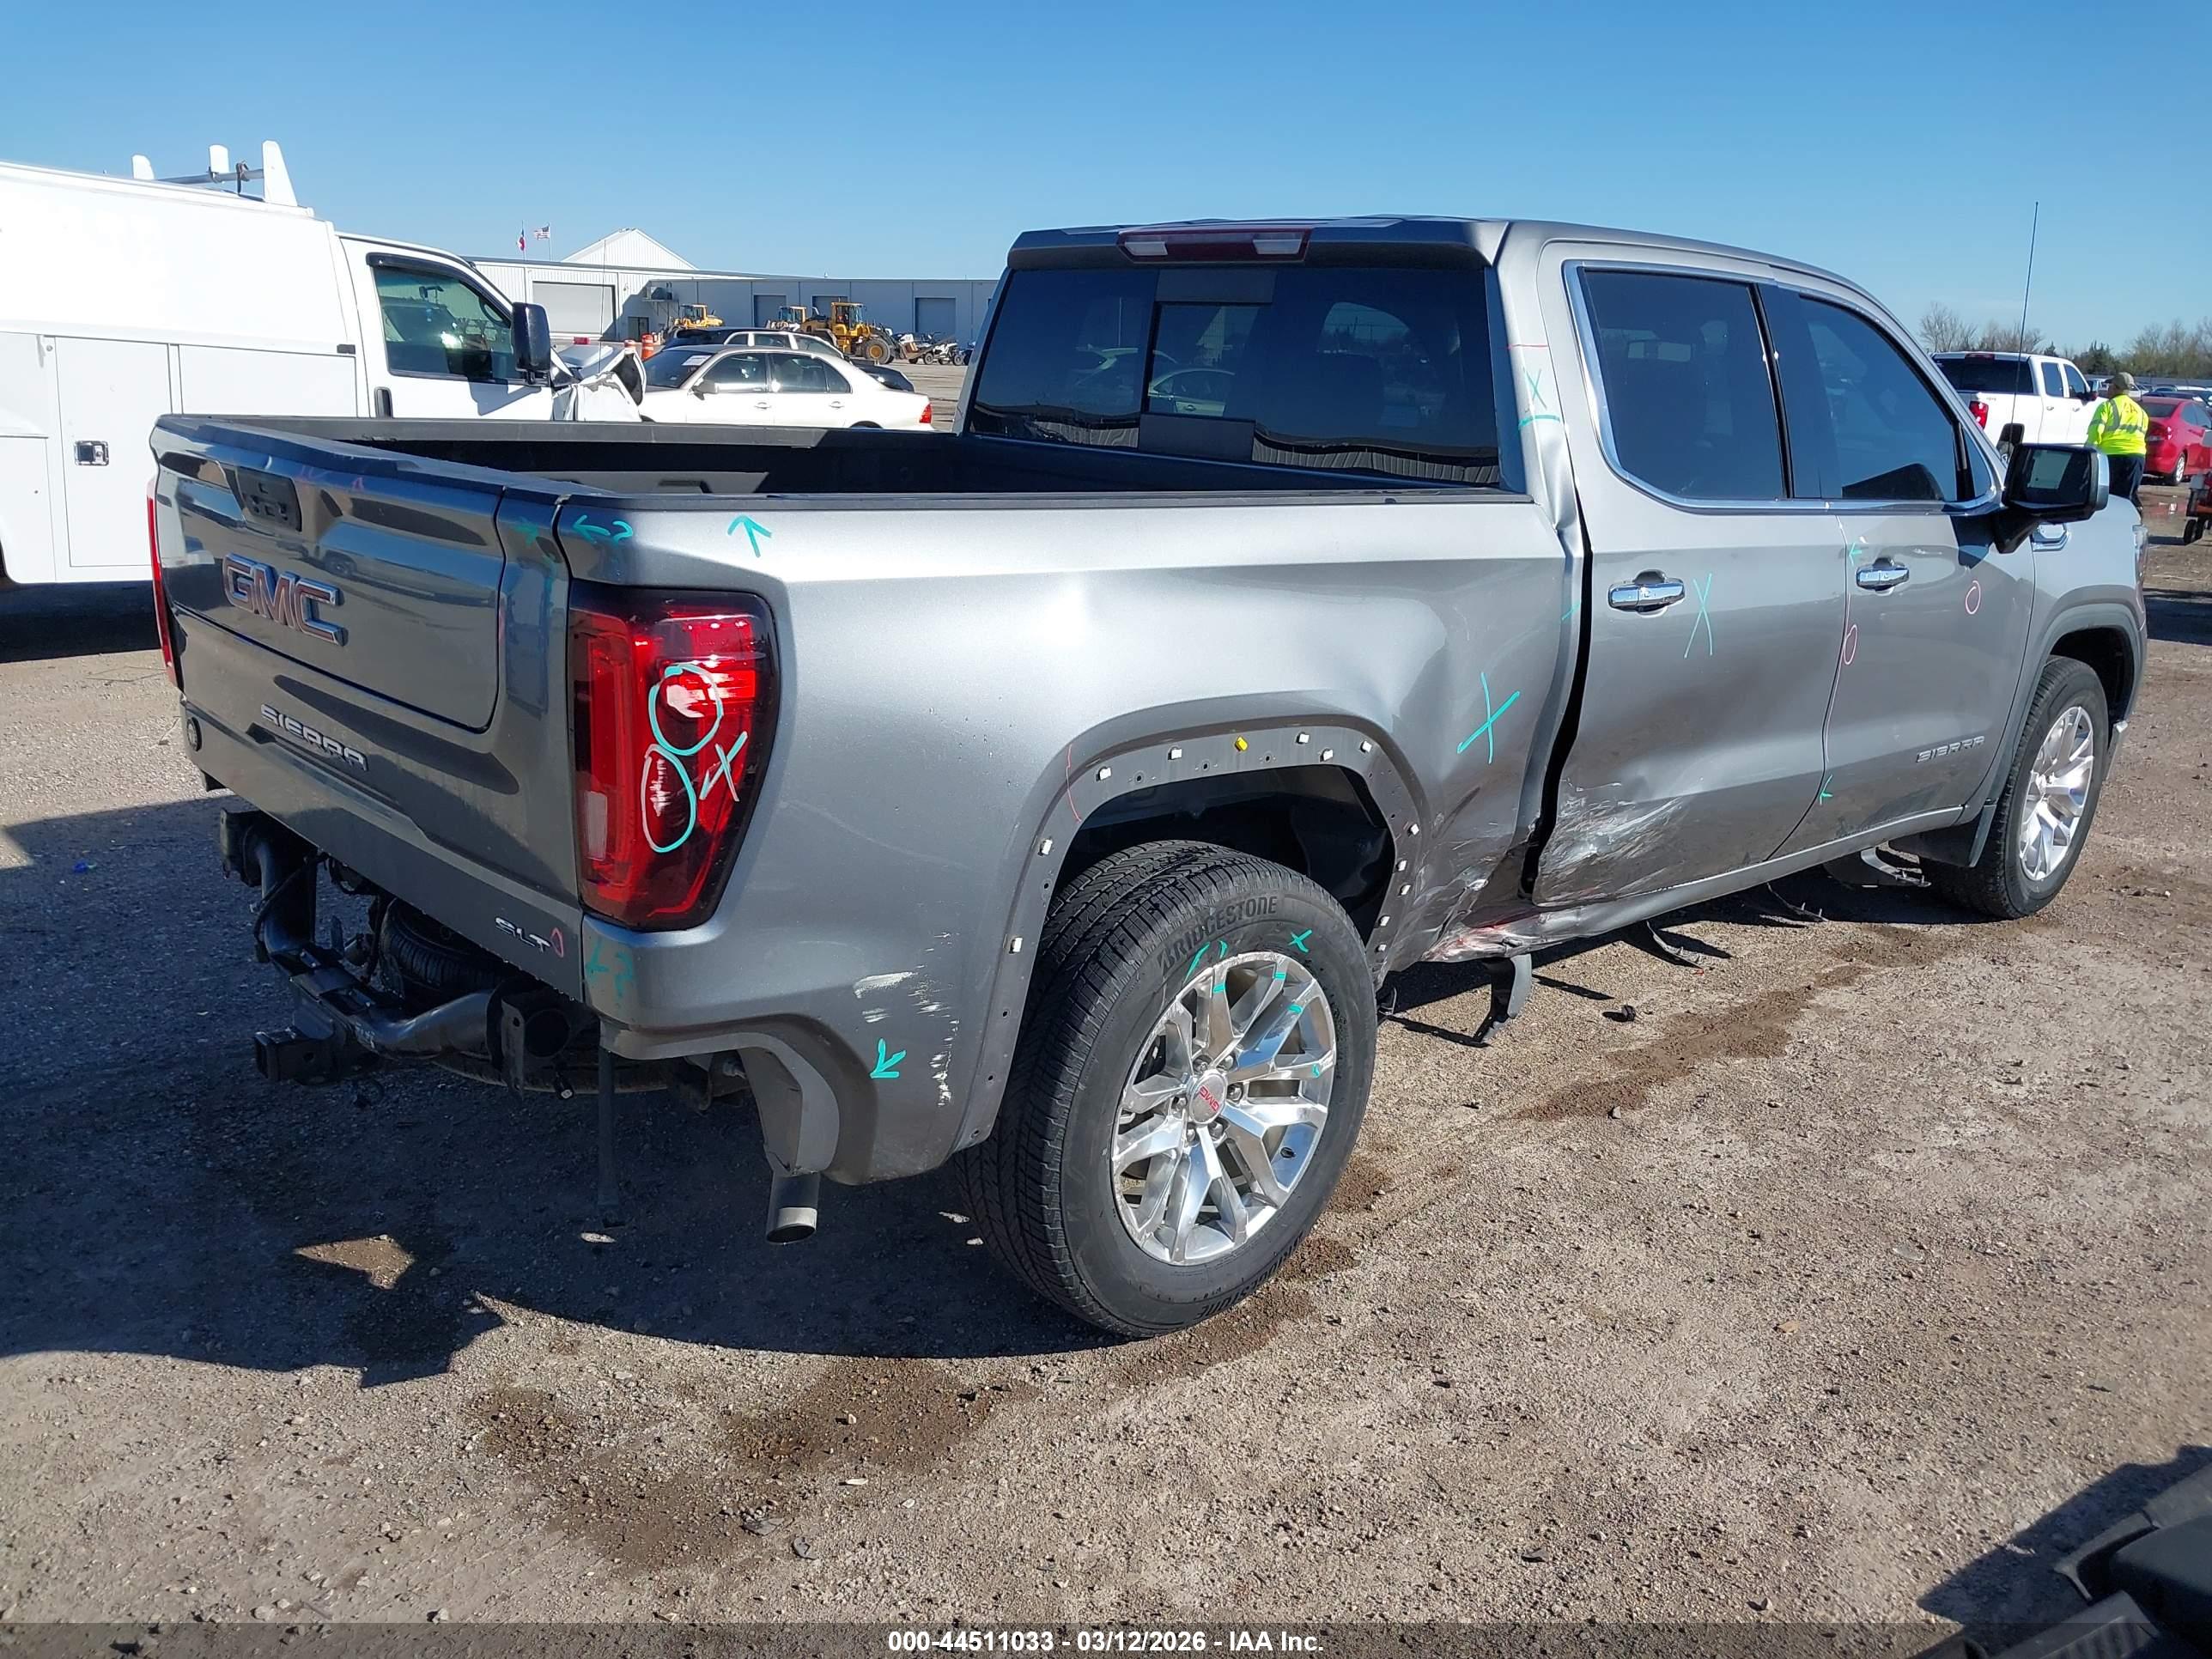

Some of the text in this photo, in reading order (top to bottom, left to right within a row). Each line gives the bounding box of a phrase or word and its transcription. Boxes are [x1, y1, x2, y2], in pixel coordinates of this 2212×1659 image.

[222, 552, 348, 647] GMC
[260, 703, 368, 771] SIERRA
[1916, 735, 1985, 763] SIERRA
[495, 917, 552, 953] SLT
[1157, 896, 1278, 977] BRIDGESTONE
[1199, 1085, 1220, 1112] GMC
